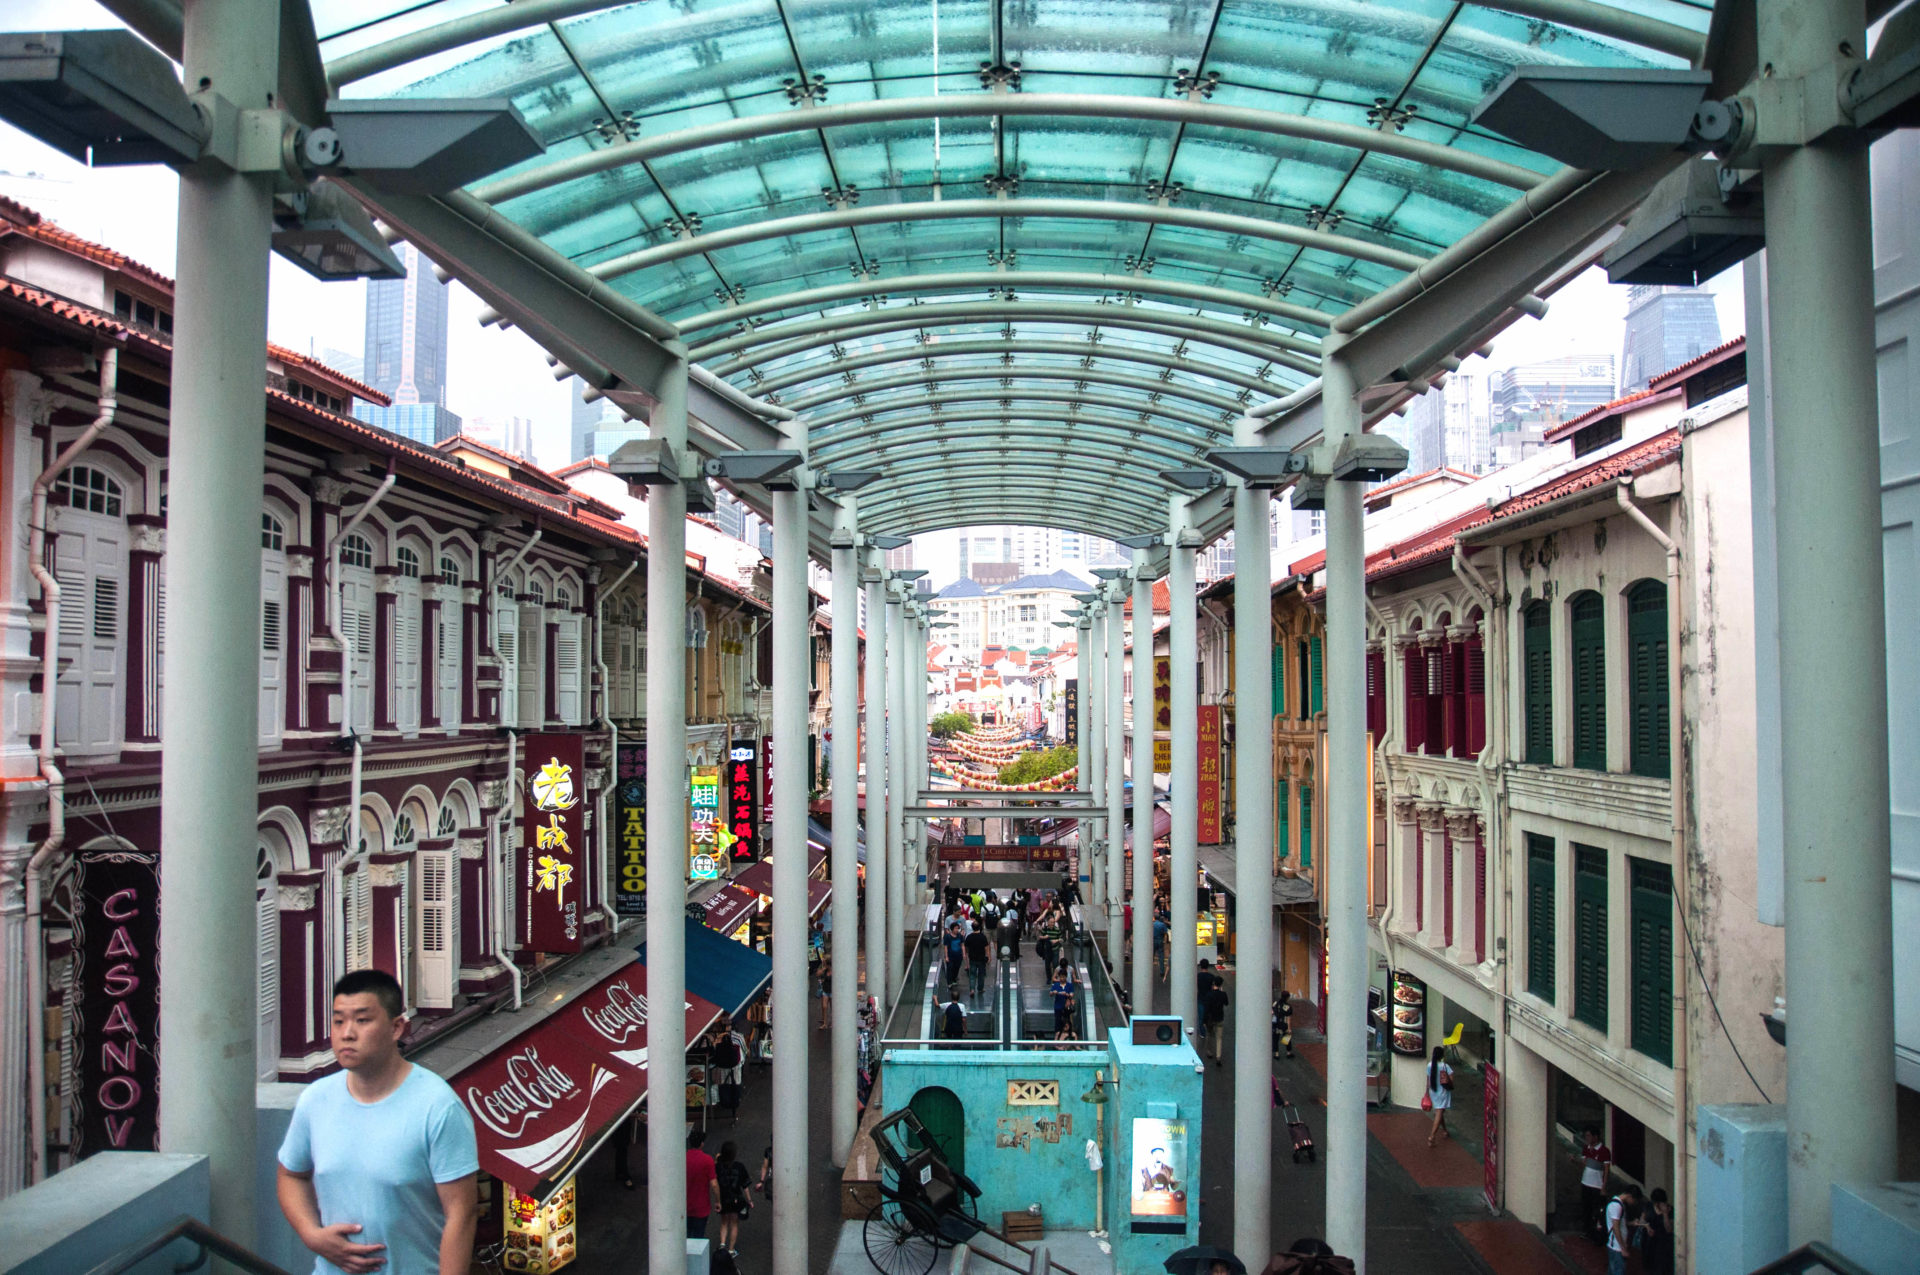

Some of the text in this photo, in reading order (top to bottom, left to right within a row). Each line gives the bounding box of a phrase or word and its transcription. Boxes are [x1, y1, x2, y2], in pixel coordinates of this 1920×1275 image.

[1201, 734, 1217, 742] XIAO
[1201, 773, 1217, 781] ZHAO
[1203, 818, 1214, 826] PAI
[622, 807, 646, 892] TATTOO
[468, 1044, 575, 1139] Coca-Cola
